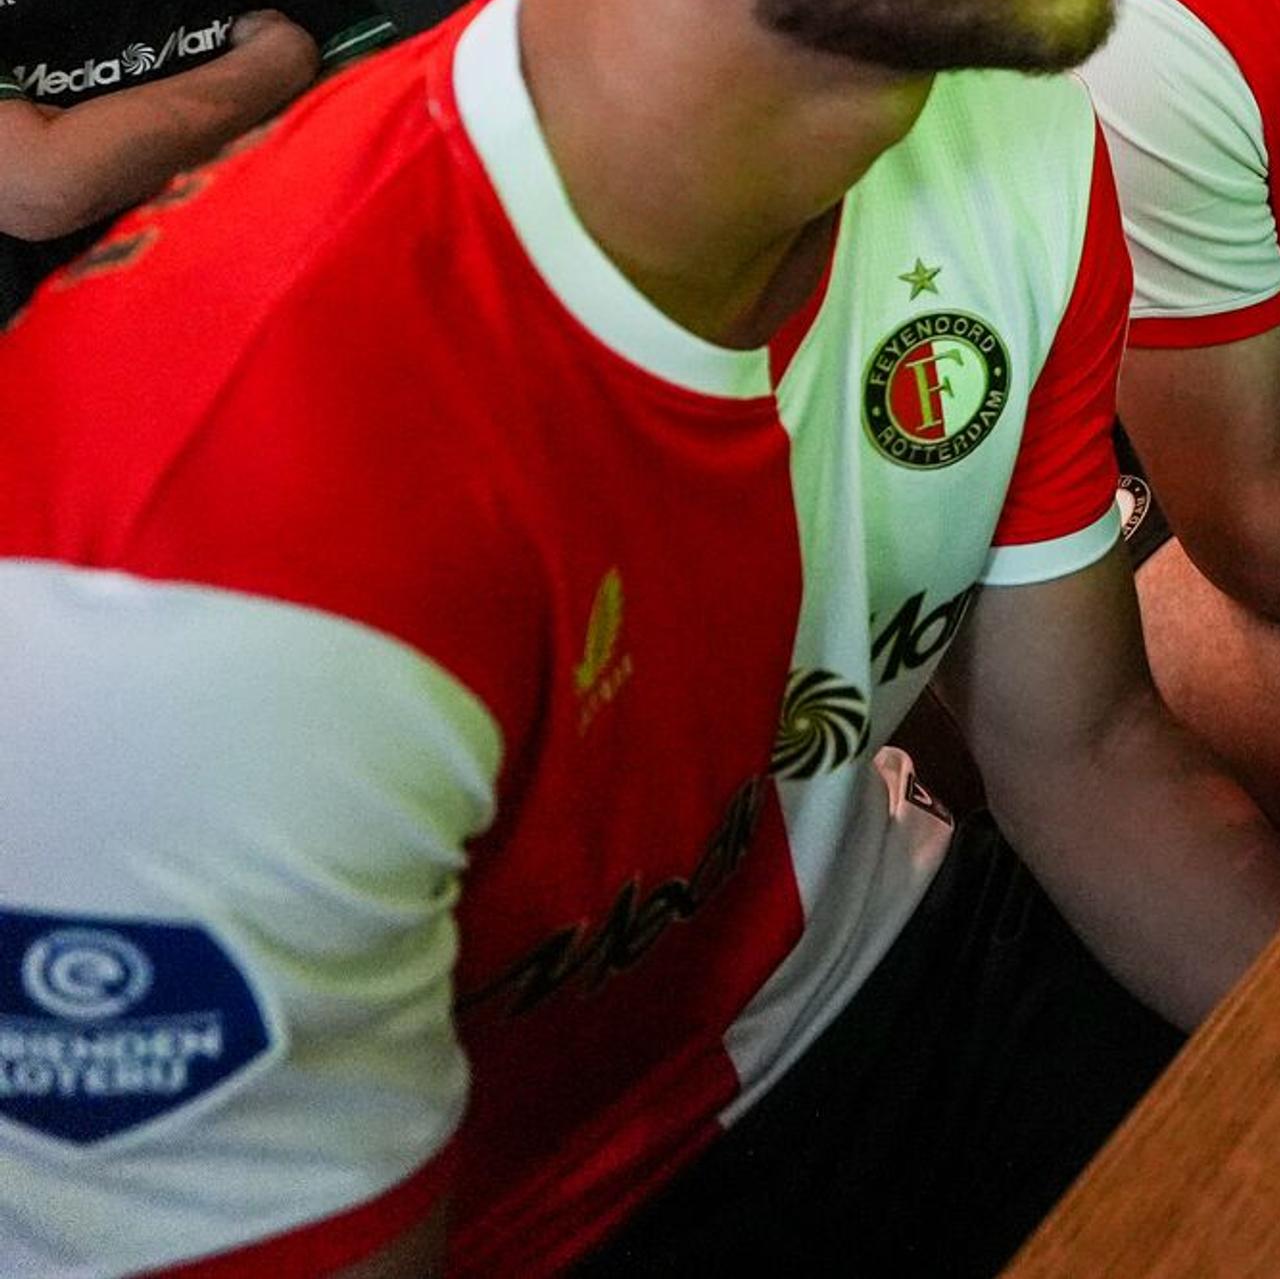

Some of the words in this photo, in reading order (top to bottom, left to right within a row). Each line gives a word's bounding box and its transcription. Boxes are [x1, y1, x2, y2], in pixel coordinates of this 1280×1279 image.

[152, 16, 234, 69] Mark
[871, 316, 996, 386] FEYENOORD
[877, 389, 1004, 463] ROTTERDAM
